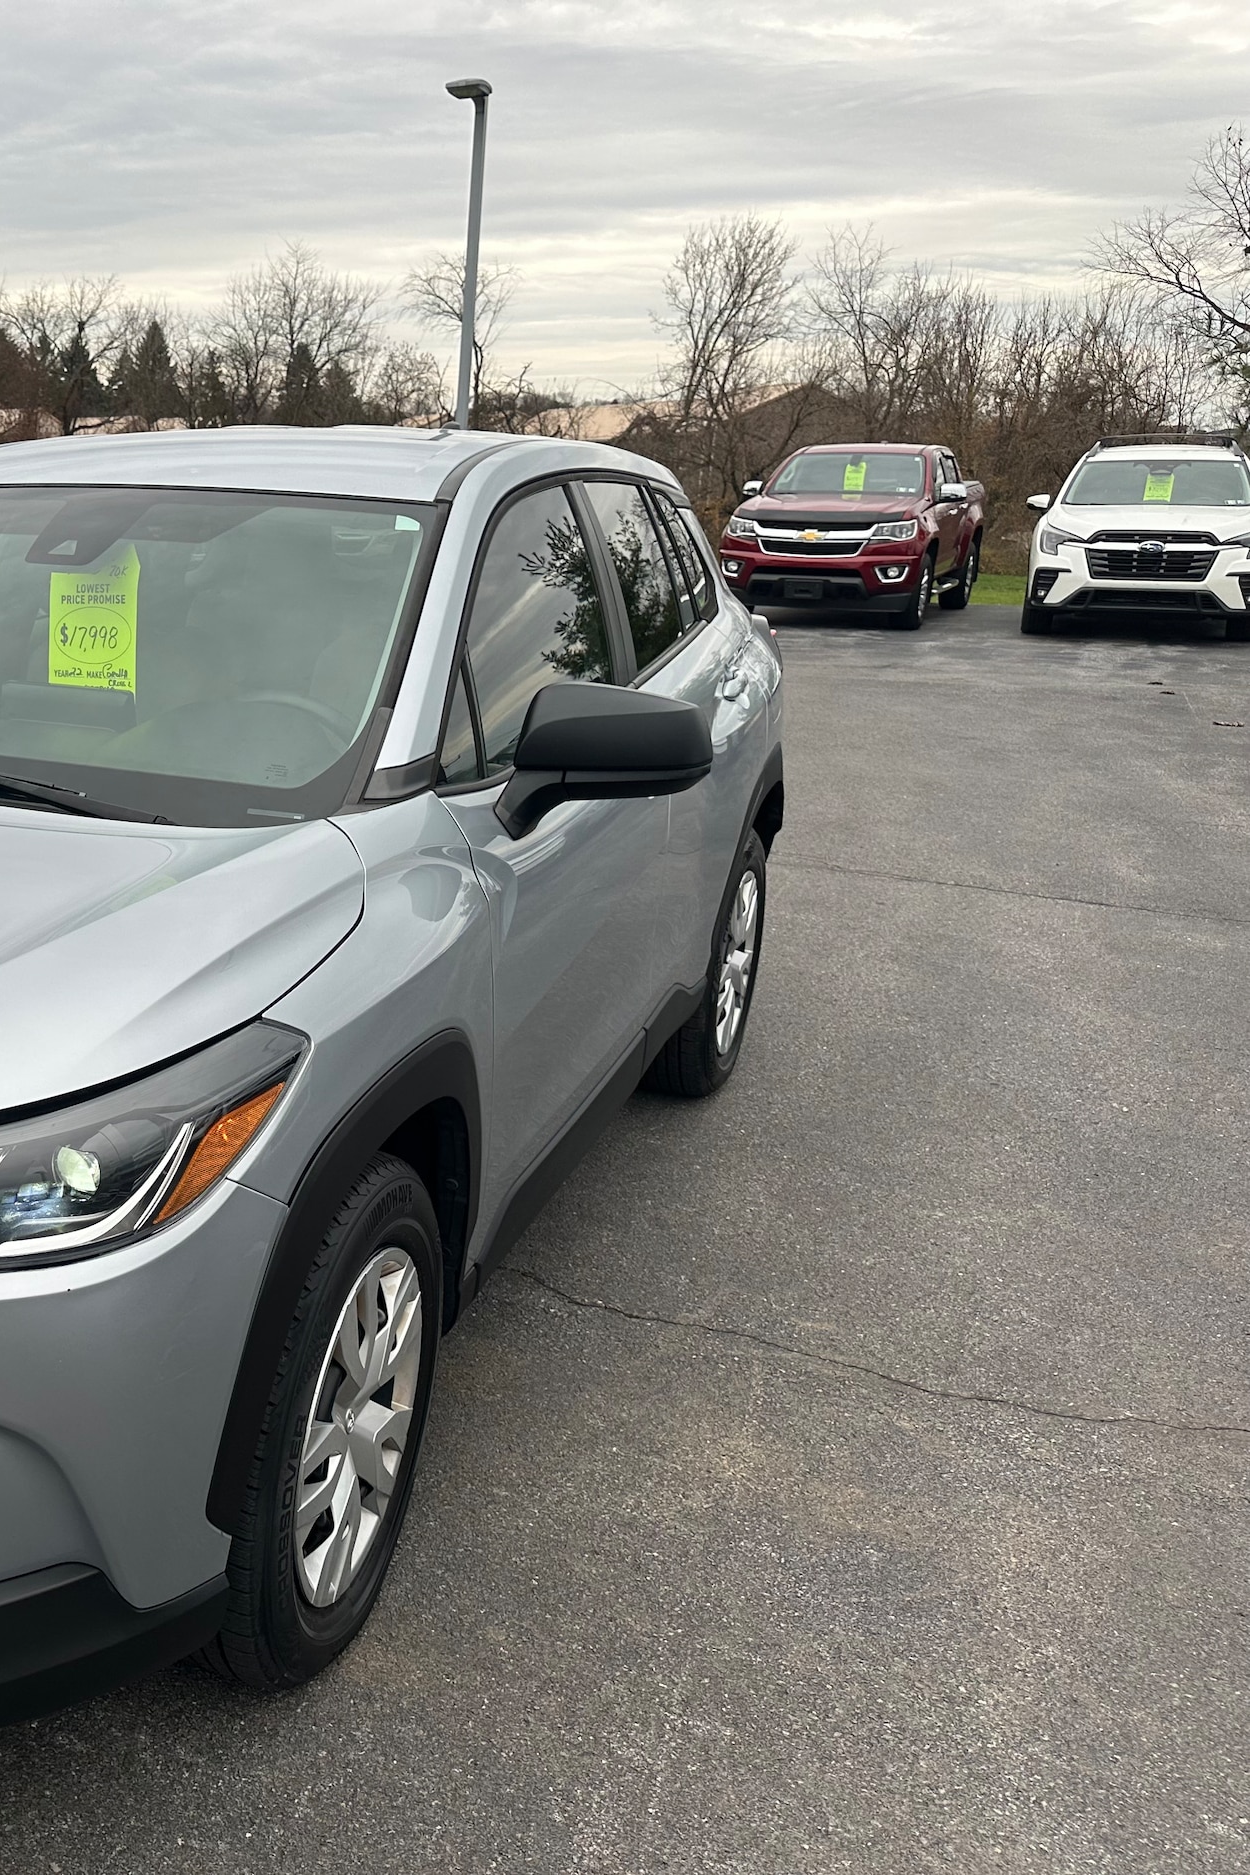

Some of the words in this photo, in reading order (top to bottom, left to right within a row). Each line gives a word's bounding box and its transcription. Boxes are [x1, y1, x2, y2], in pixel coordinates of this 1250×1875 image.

[76, 583, 110, 593] LOWEST
[61, 594, 85, 604] PRICE
[88, 594, 126, 604] PROMISE
[87, 670, 102, 679] MAKE
[377, 1183, 412, 1222] MOHAVE
